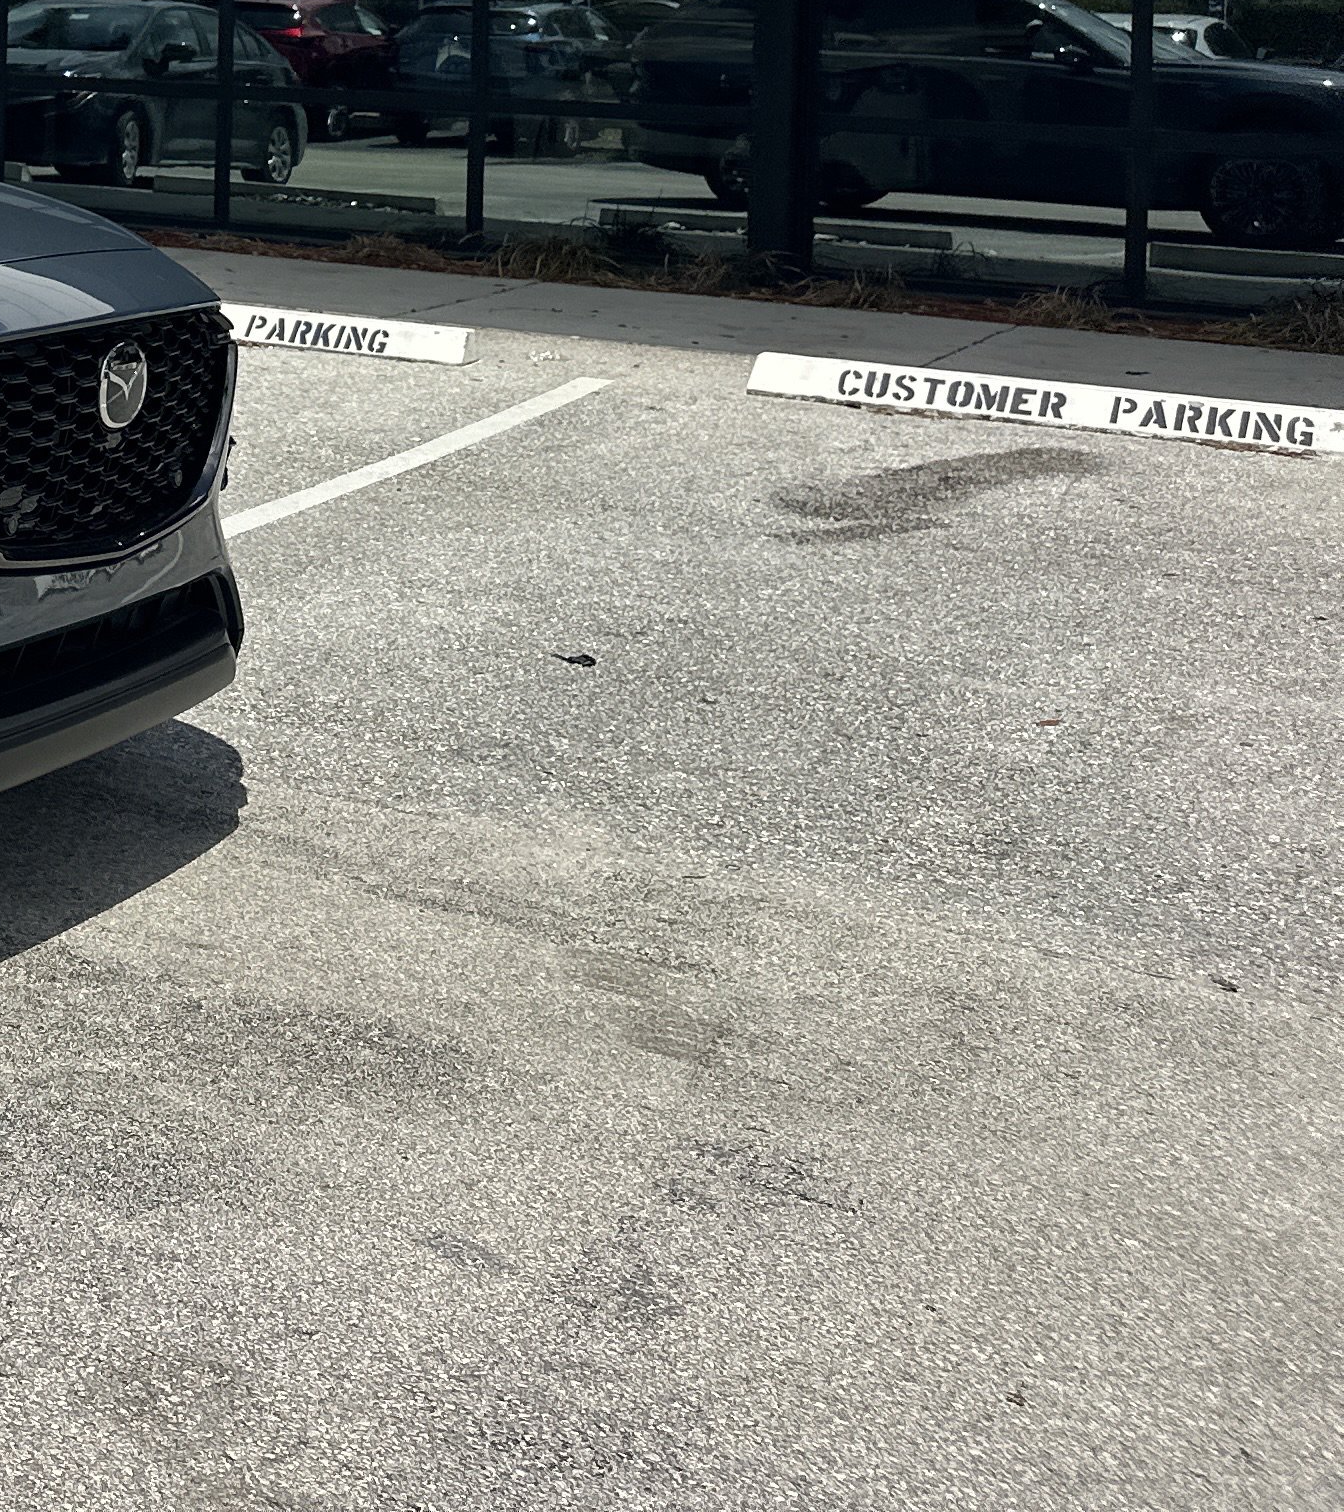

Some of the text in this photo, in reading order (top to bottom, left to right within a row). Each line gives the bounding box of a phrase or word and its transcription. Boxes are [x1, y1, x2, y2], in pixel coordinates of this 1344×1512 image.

[244, 314, 390, 354] PARKING
[837, 369, 1315, 447] CUSTOMER PARKING
